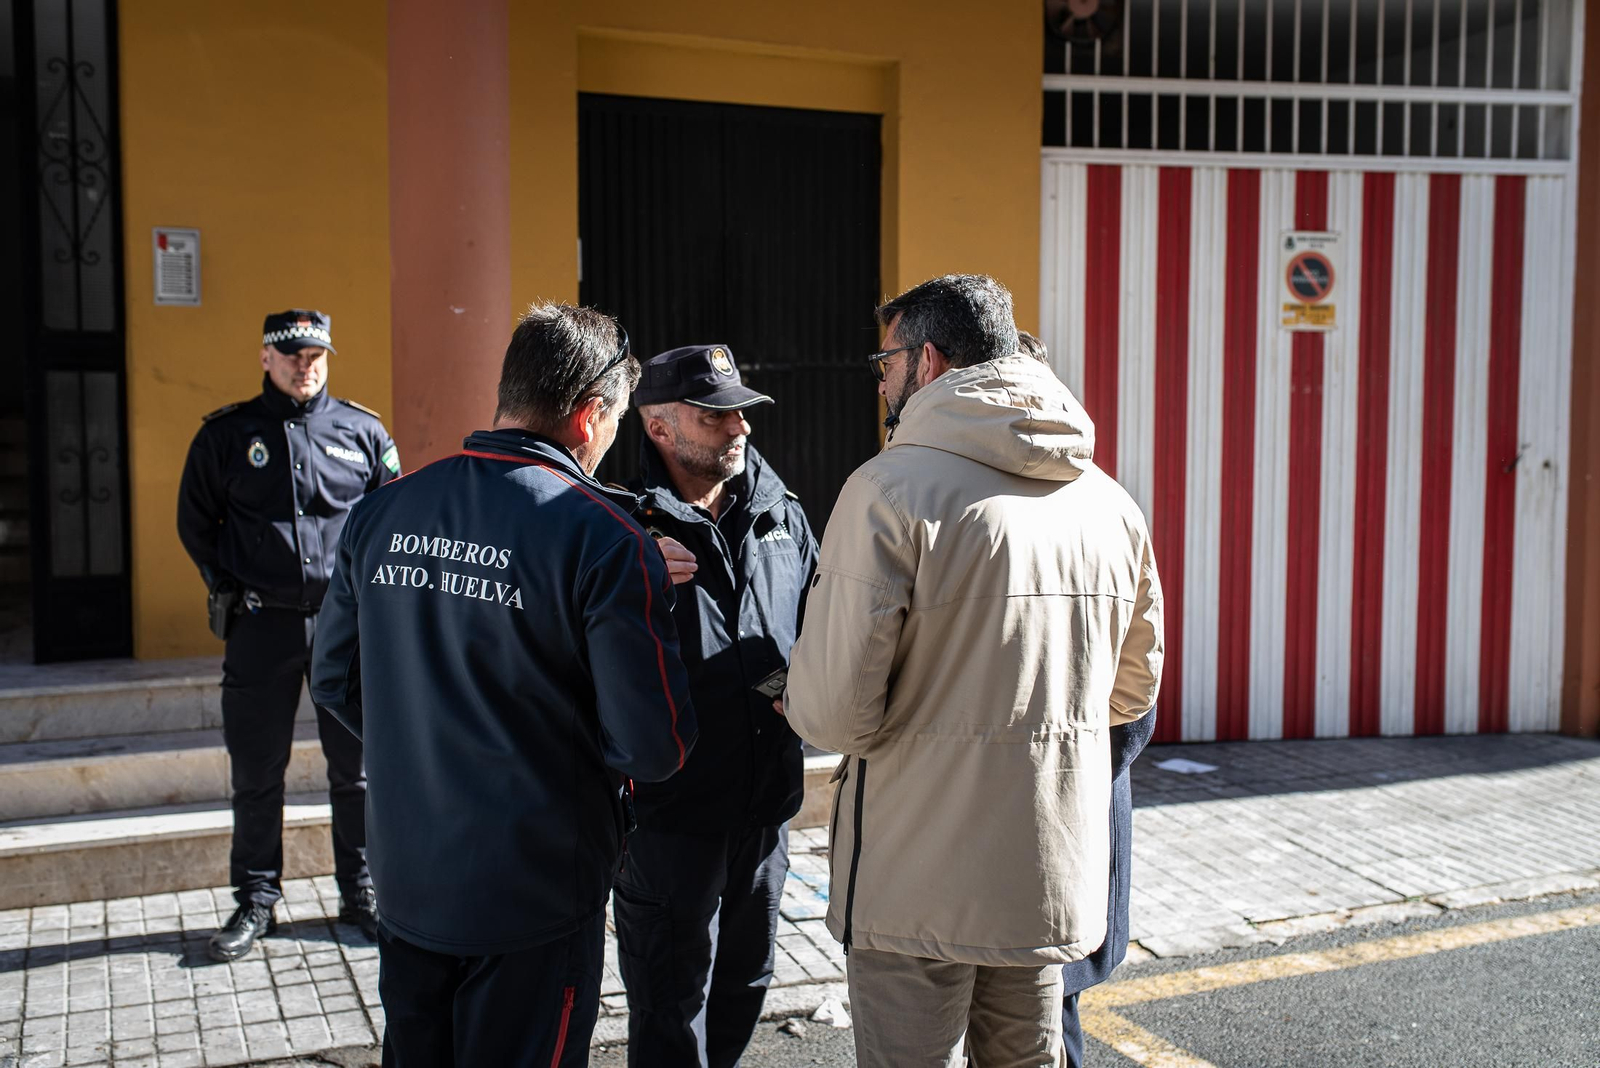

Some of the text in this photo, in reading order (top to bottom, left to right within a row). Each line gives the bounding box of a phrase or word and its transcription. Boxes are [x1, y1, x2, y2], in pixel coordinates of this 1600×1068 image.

[388, 533, 512, 570] BOMBEROS
[370, 564, 525, 610] AYTO. HUELVA
